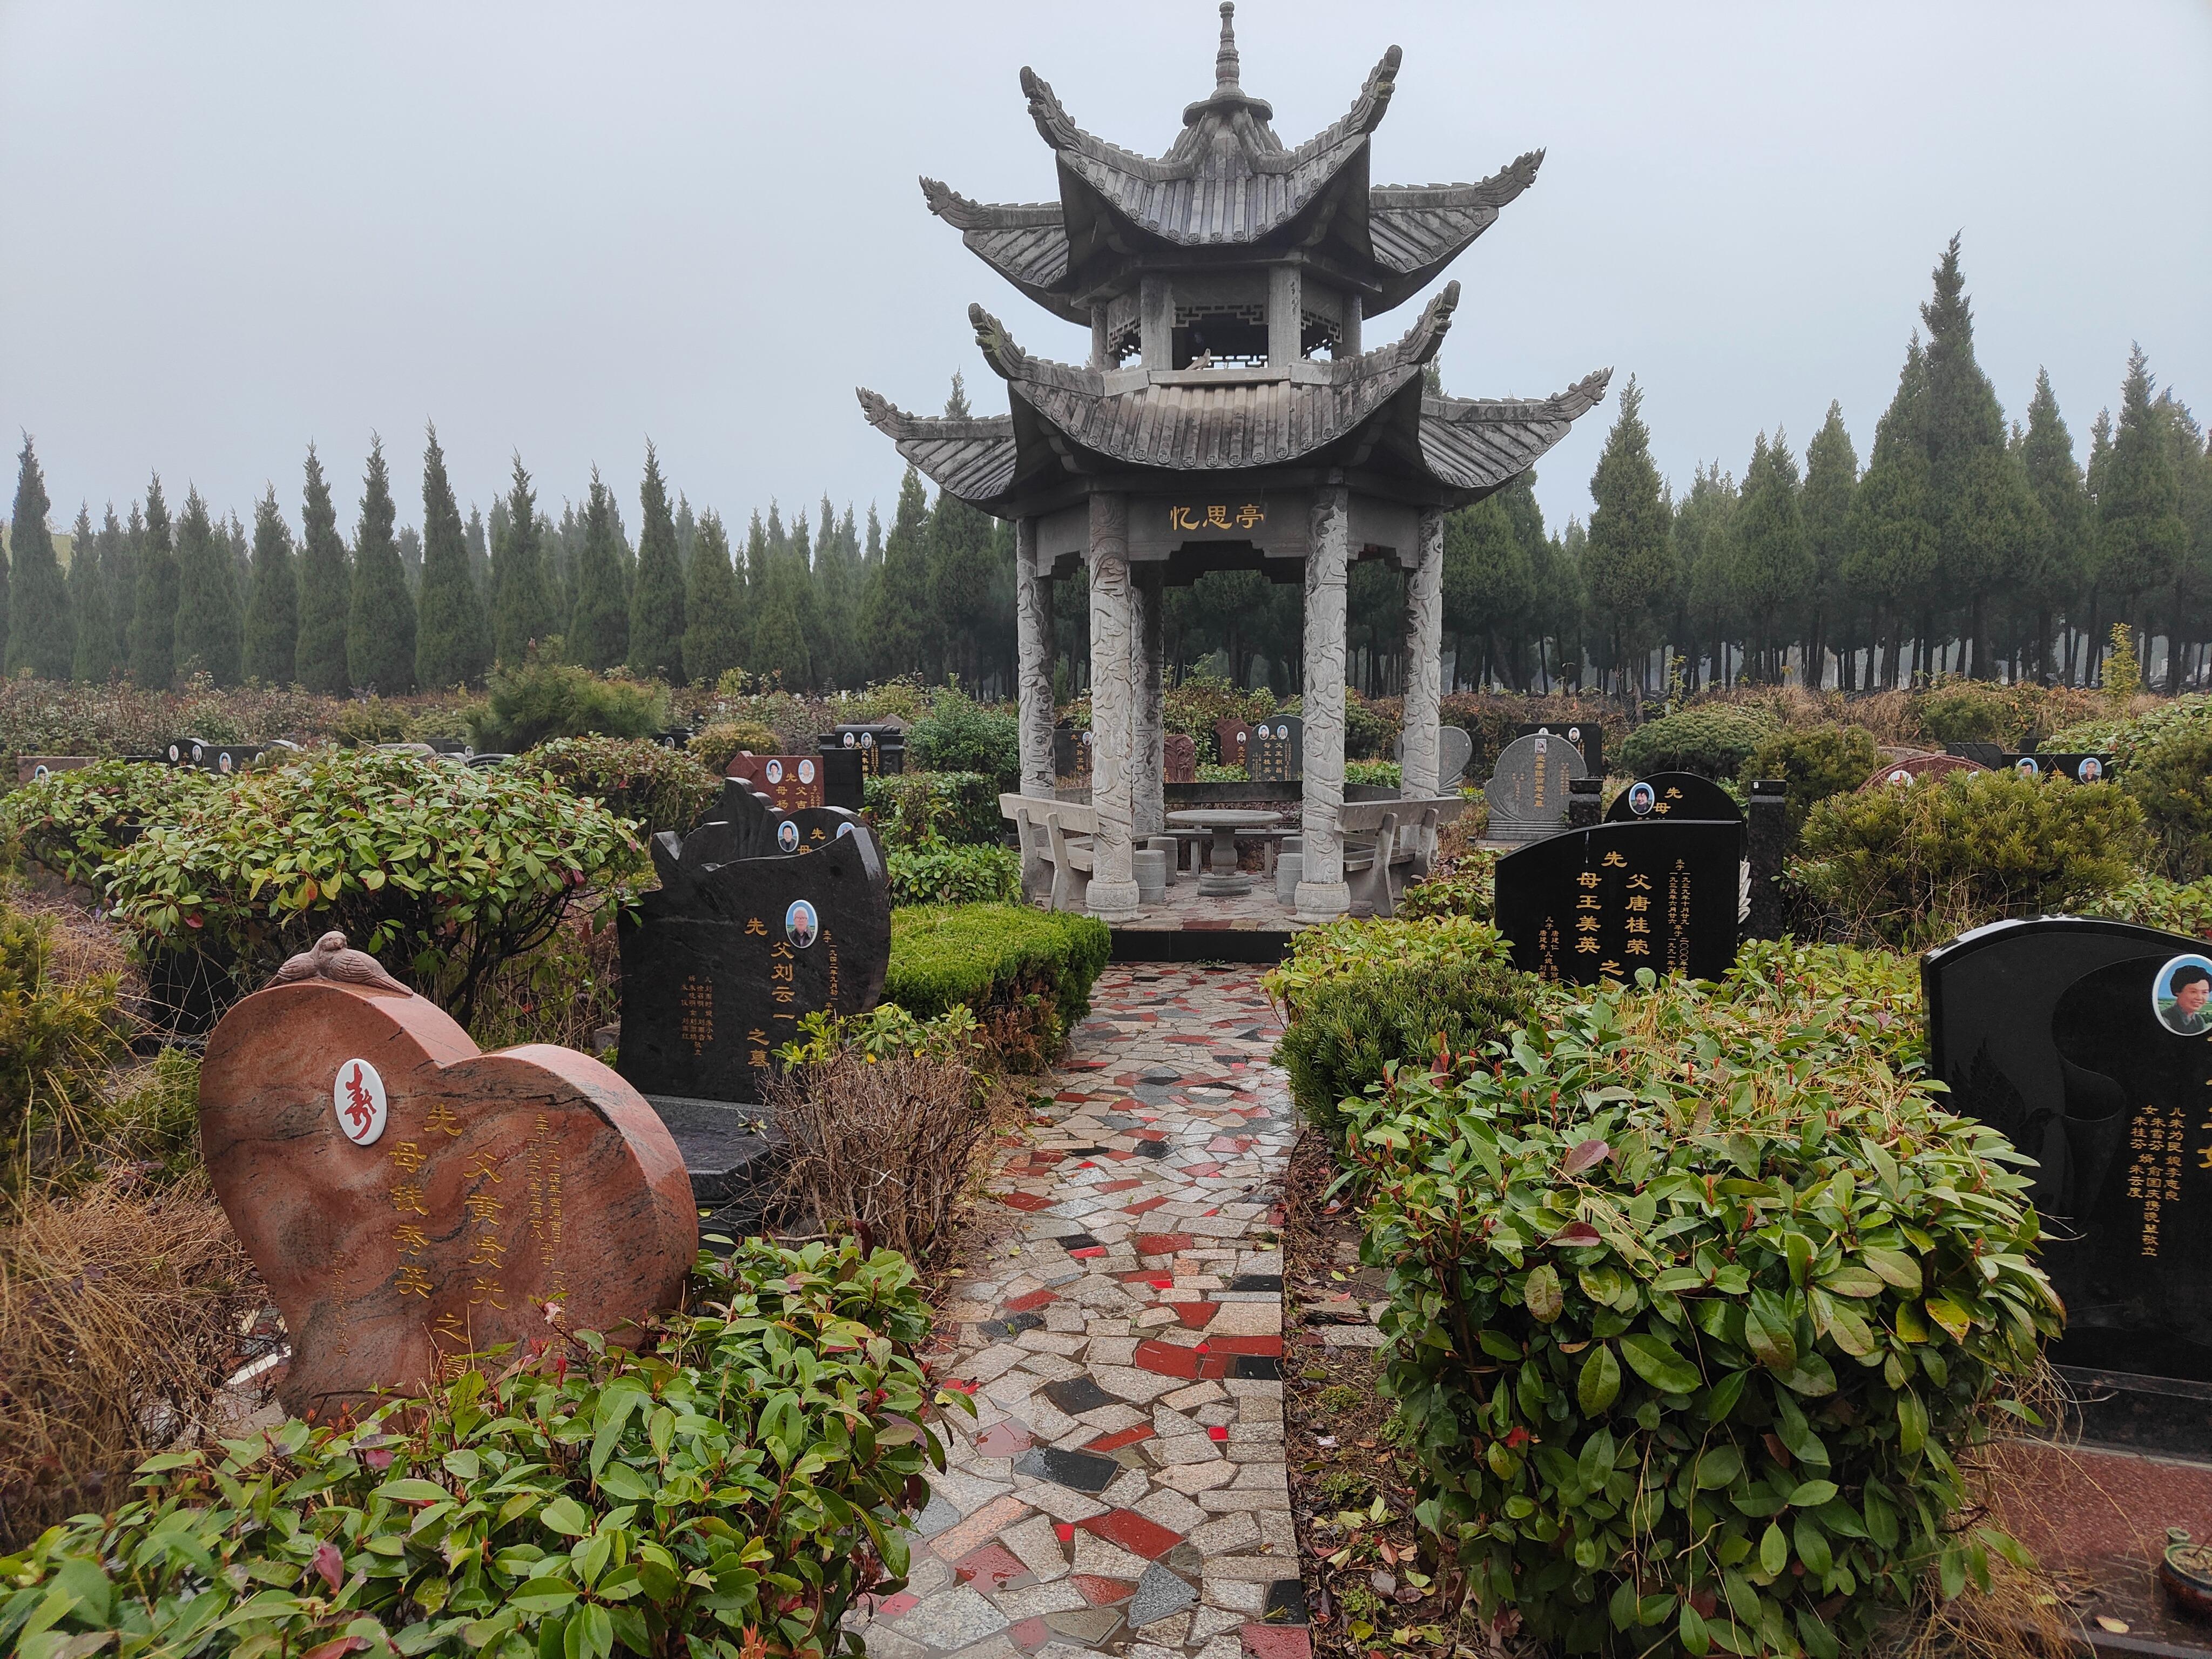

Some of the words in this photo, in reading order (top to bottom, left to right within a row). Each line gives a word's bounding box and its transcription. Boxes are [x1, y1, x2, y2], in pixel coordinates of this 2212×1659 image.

[1170, 503, 1264, 530] 忆思亭
[785, 772, 798, 782] 先
[1664, 787, 1683, 799] 先
[1653, 802, 1671, 814] 母
[810, 827, 826, 840] 先
[797, 845, 813, 855] 母
[1601, 851, 1628, 868] 先
[1575, 872, 1602, 954] 母王美英
[1624, 873, 1653, 955] 父唐桂荣
[744, 917, 768, 936] 先
[770, 941, 795, 1020] 父刘云一
[747, 1028, 771, 1068] 之墓
[423, 1102, 464, 1136] 先
[2141, 1105, 2160, 1115] 女
